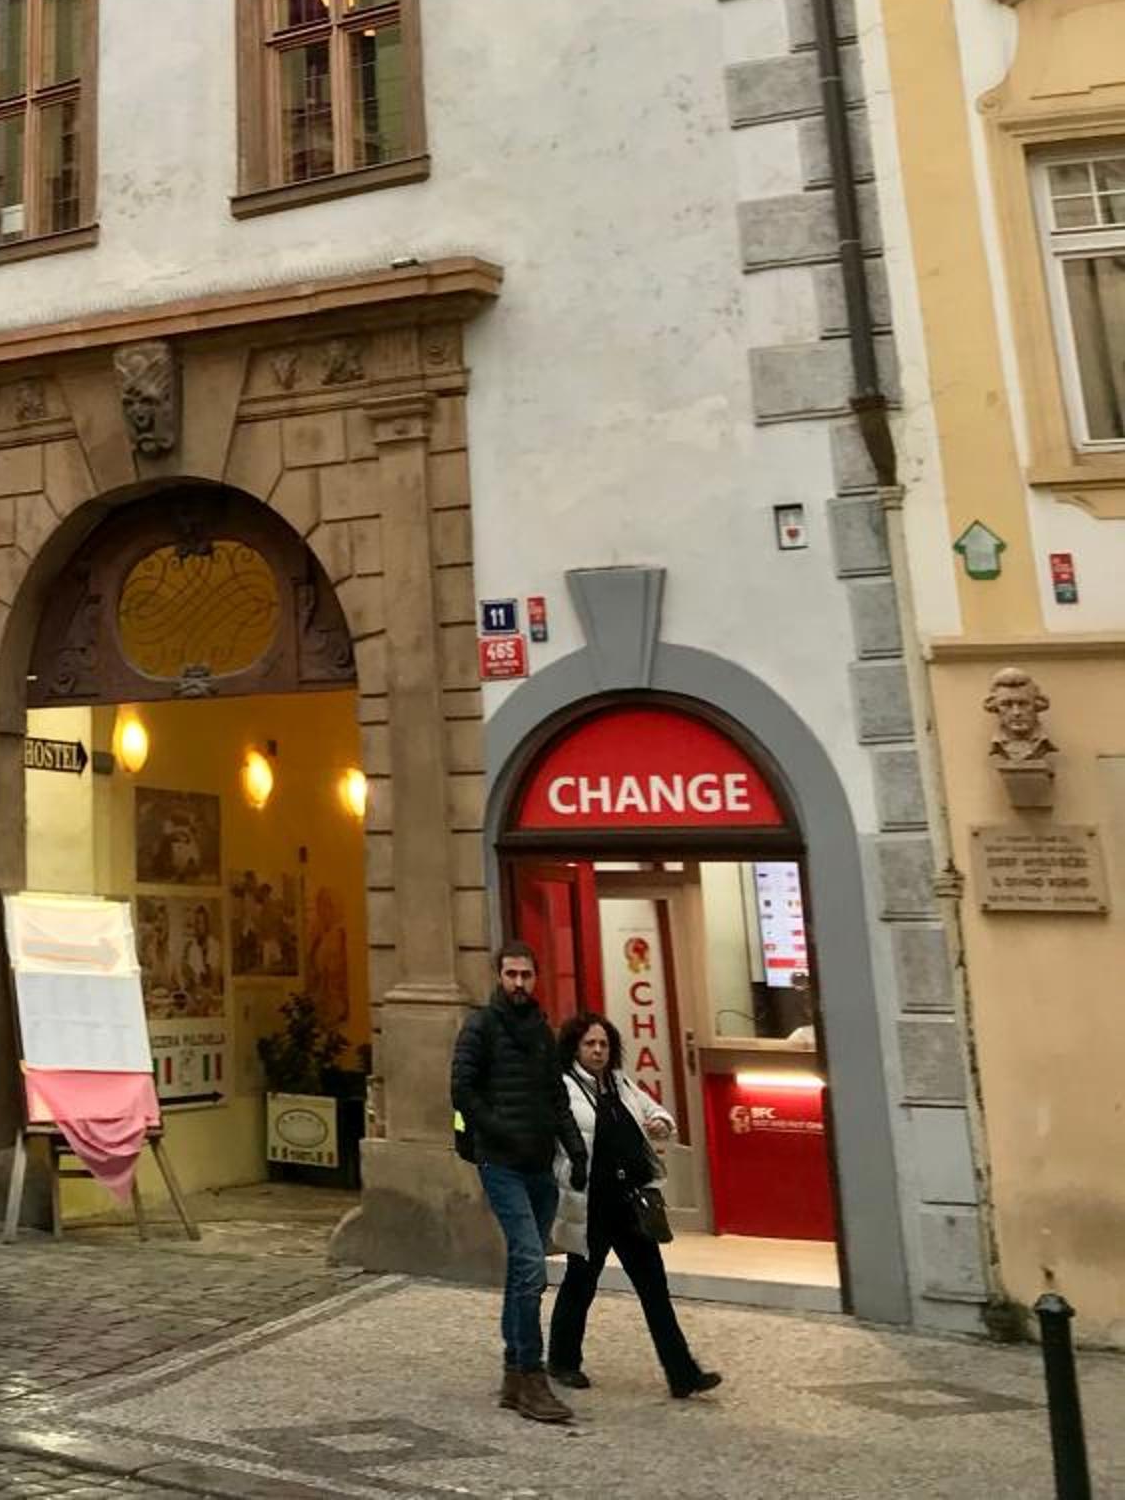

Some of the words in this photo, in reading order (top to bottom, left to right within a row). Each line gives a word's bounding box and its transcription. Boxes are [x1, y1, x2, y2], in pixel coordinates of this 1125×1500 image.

[489, 607, 506, 628] 11
[486, 641, 516, 660] 465
[24, 740, 81, 770] HOSTEL
[548, 773, 751, 815] CHANGE
[629, 981, 663, 1110] CHAN
